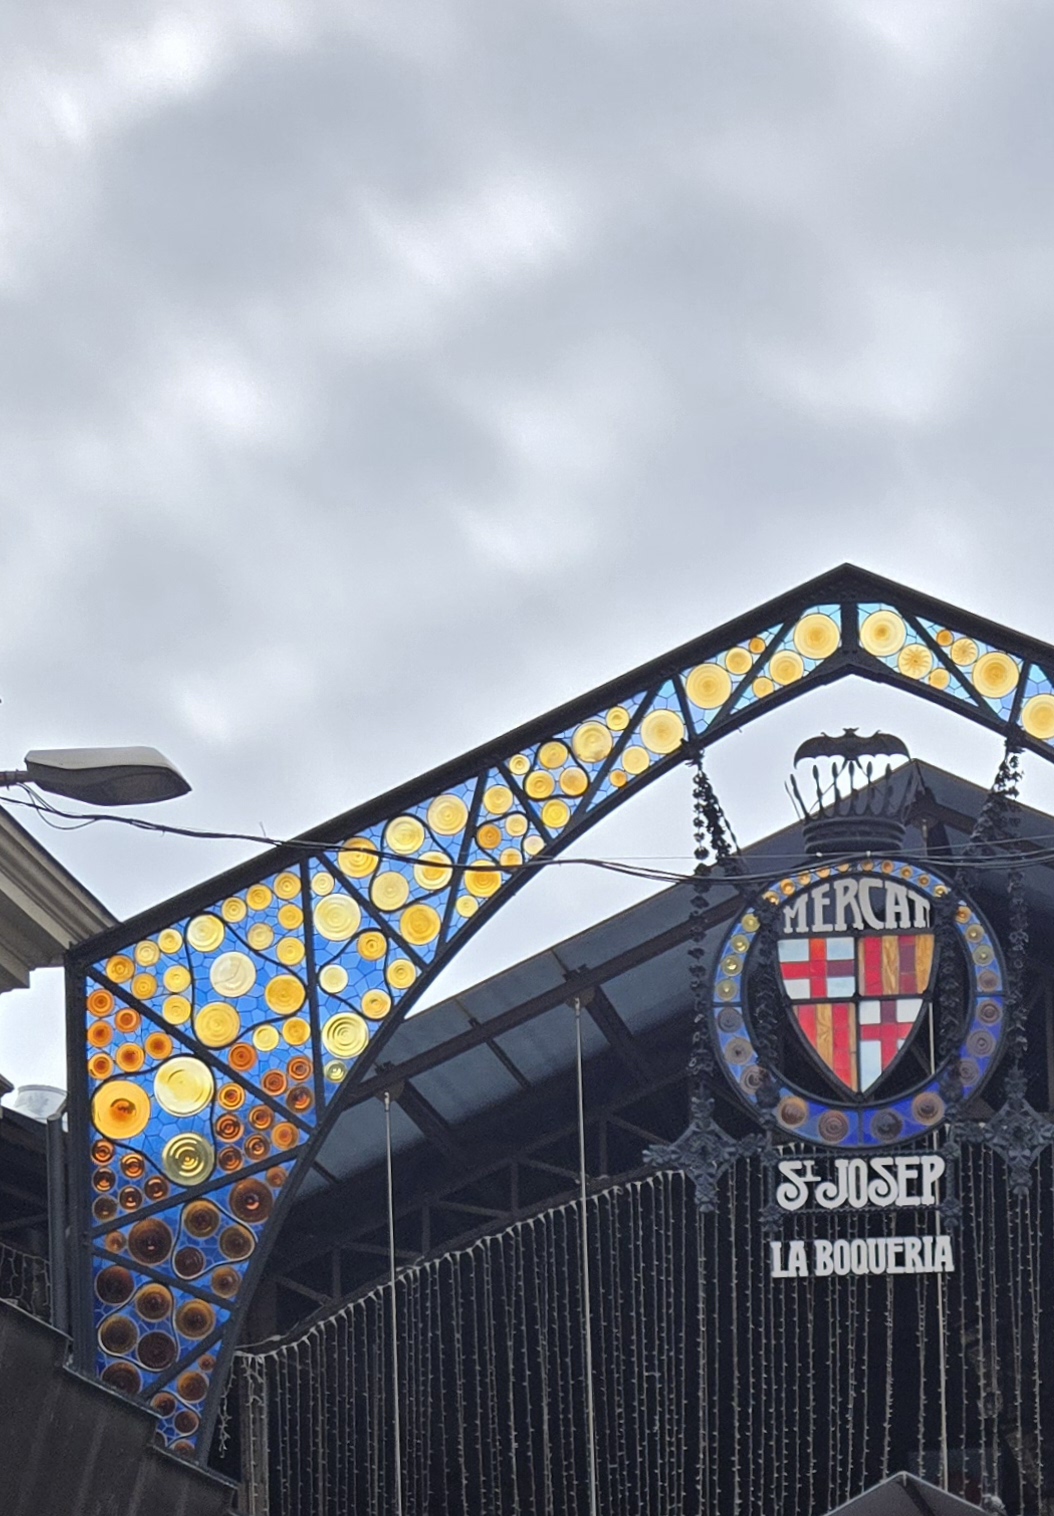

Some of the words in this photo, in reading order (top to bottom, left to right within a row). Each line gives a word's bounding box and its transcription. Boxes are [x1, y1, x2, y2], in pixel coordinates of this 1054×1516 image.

[783, 878, 930, 933] MERCAT
[814, 1154, 945, 1209] JOSEP
[771, 1241, 809, 1278] LA
[813, 1235, 955, 1277] BOQUERIA
